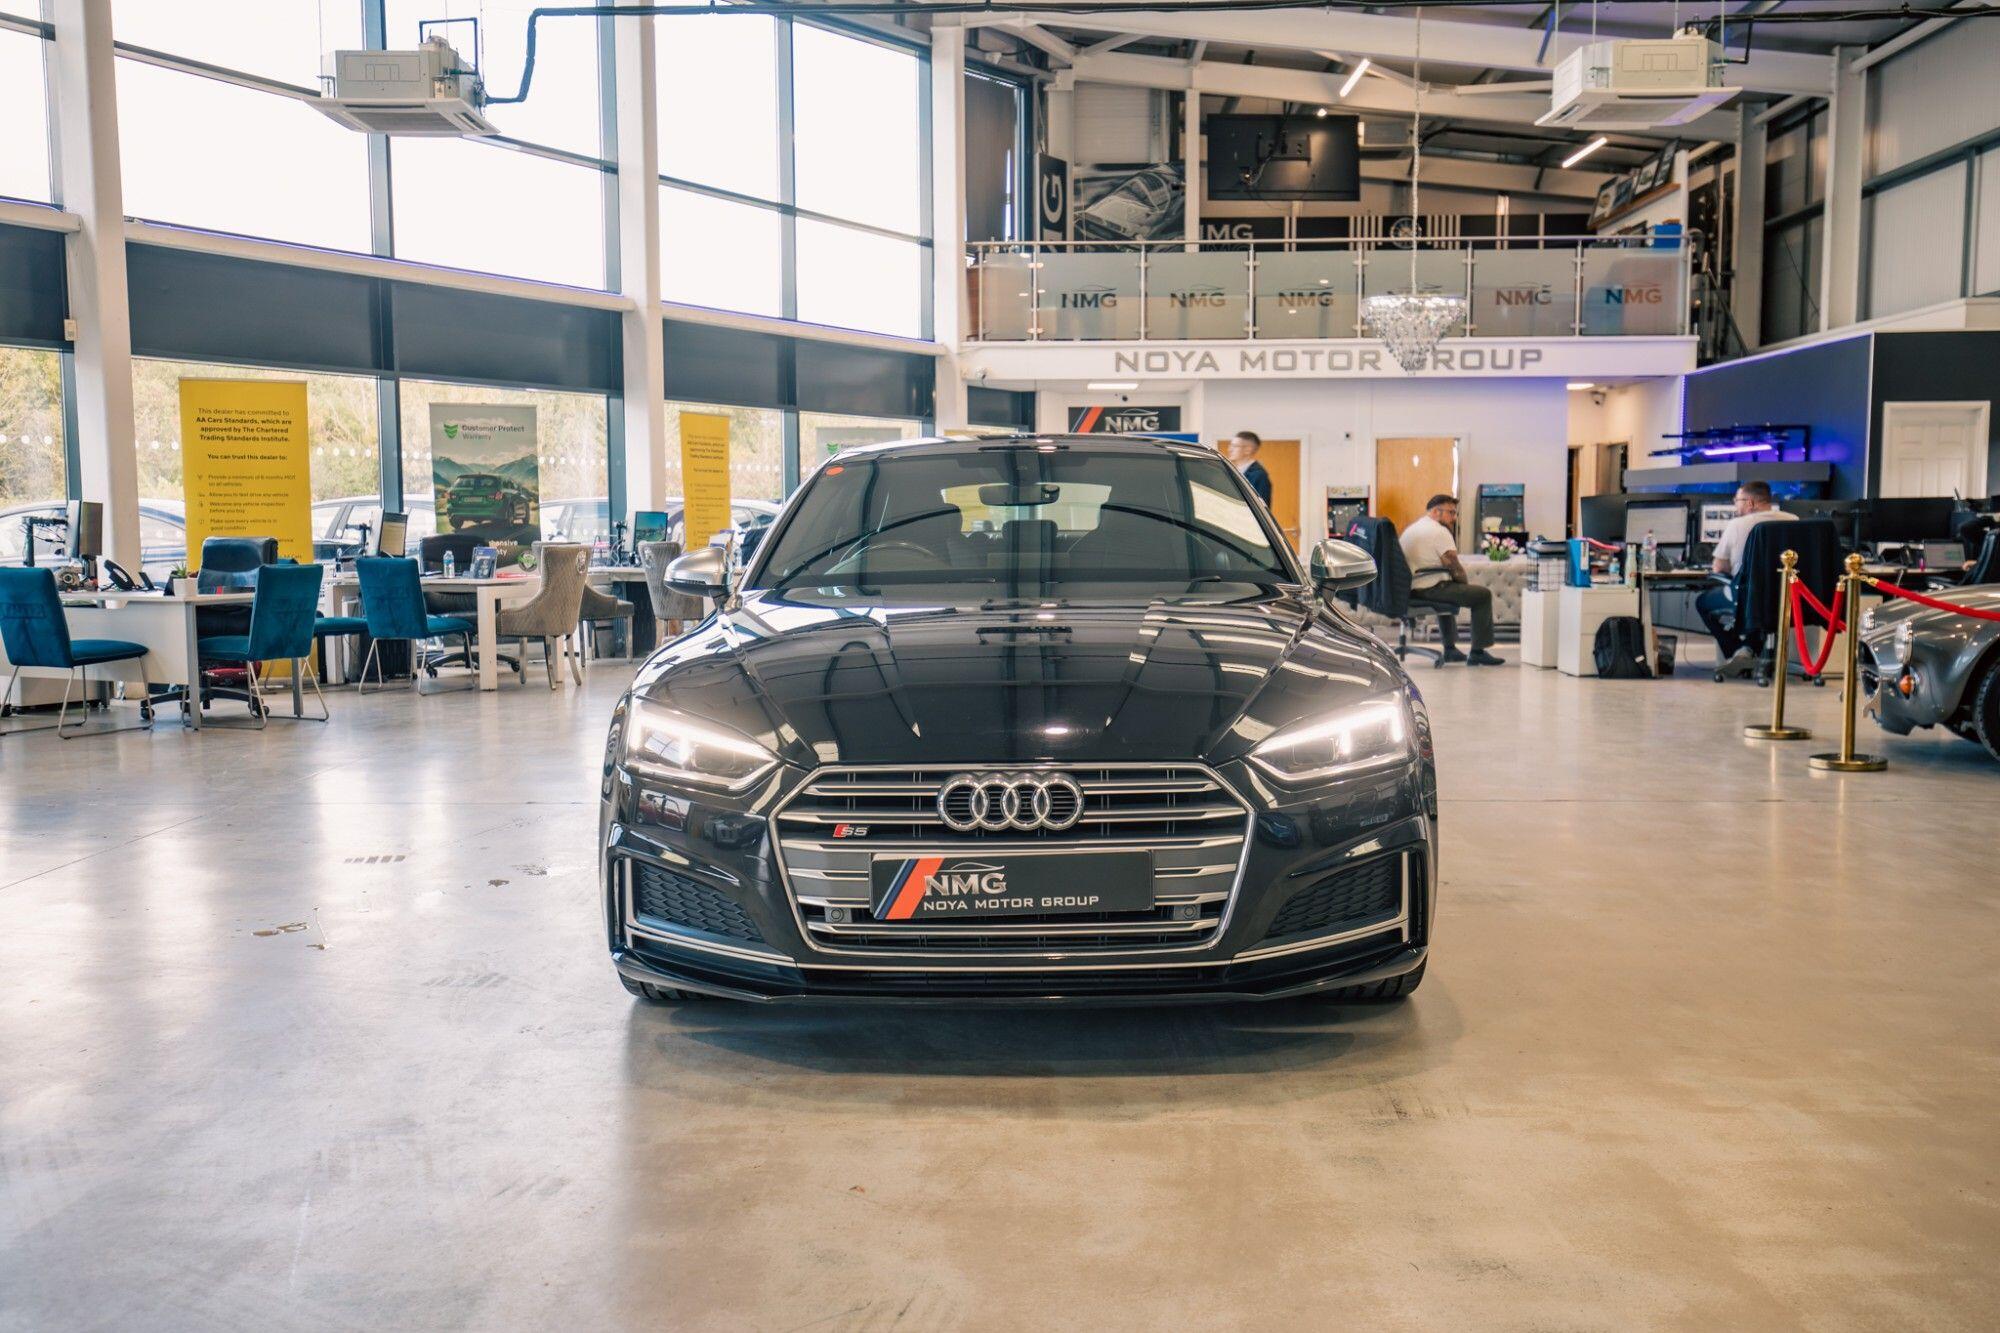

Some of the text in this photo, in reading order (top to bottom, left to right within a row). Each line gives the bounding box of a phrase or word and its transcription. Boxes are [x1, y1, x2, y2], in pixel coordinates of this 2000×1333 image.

[1061, 292, 1117, 308] NMG
[1170, 292, 1226, 308] NMG
[1278, 292, 1334, 308] NMG
[1496, 290, 1552, 306] NMG
[1606, 288, 1662, 304] NMG
[1114, 350, 1220, 372] NOYA
[1240, 350, 1382, 371] MOTOR
[1104, 414, 1160, 433] NMG
[924, 872, 1007, 896] NMG
[924, 896, 1099, 911] NOYA MOTOR GROUP
